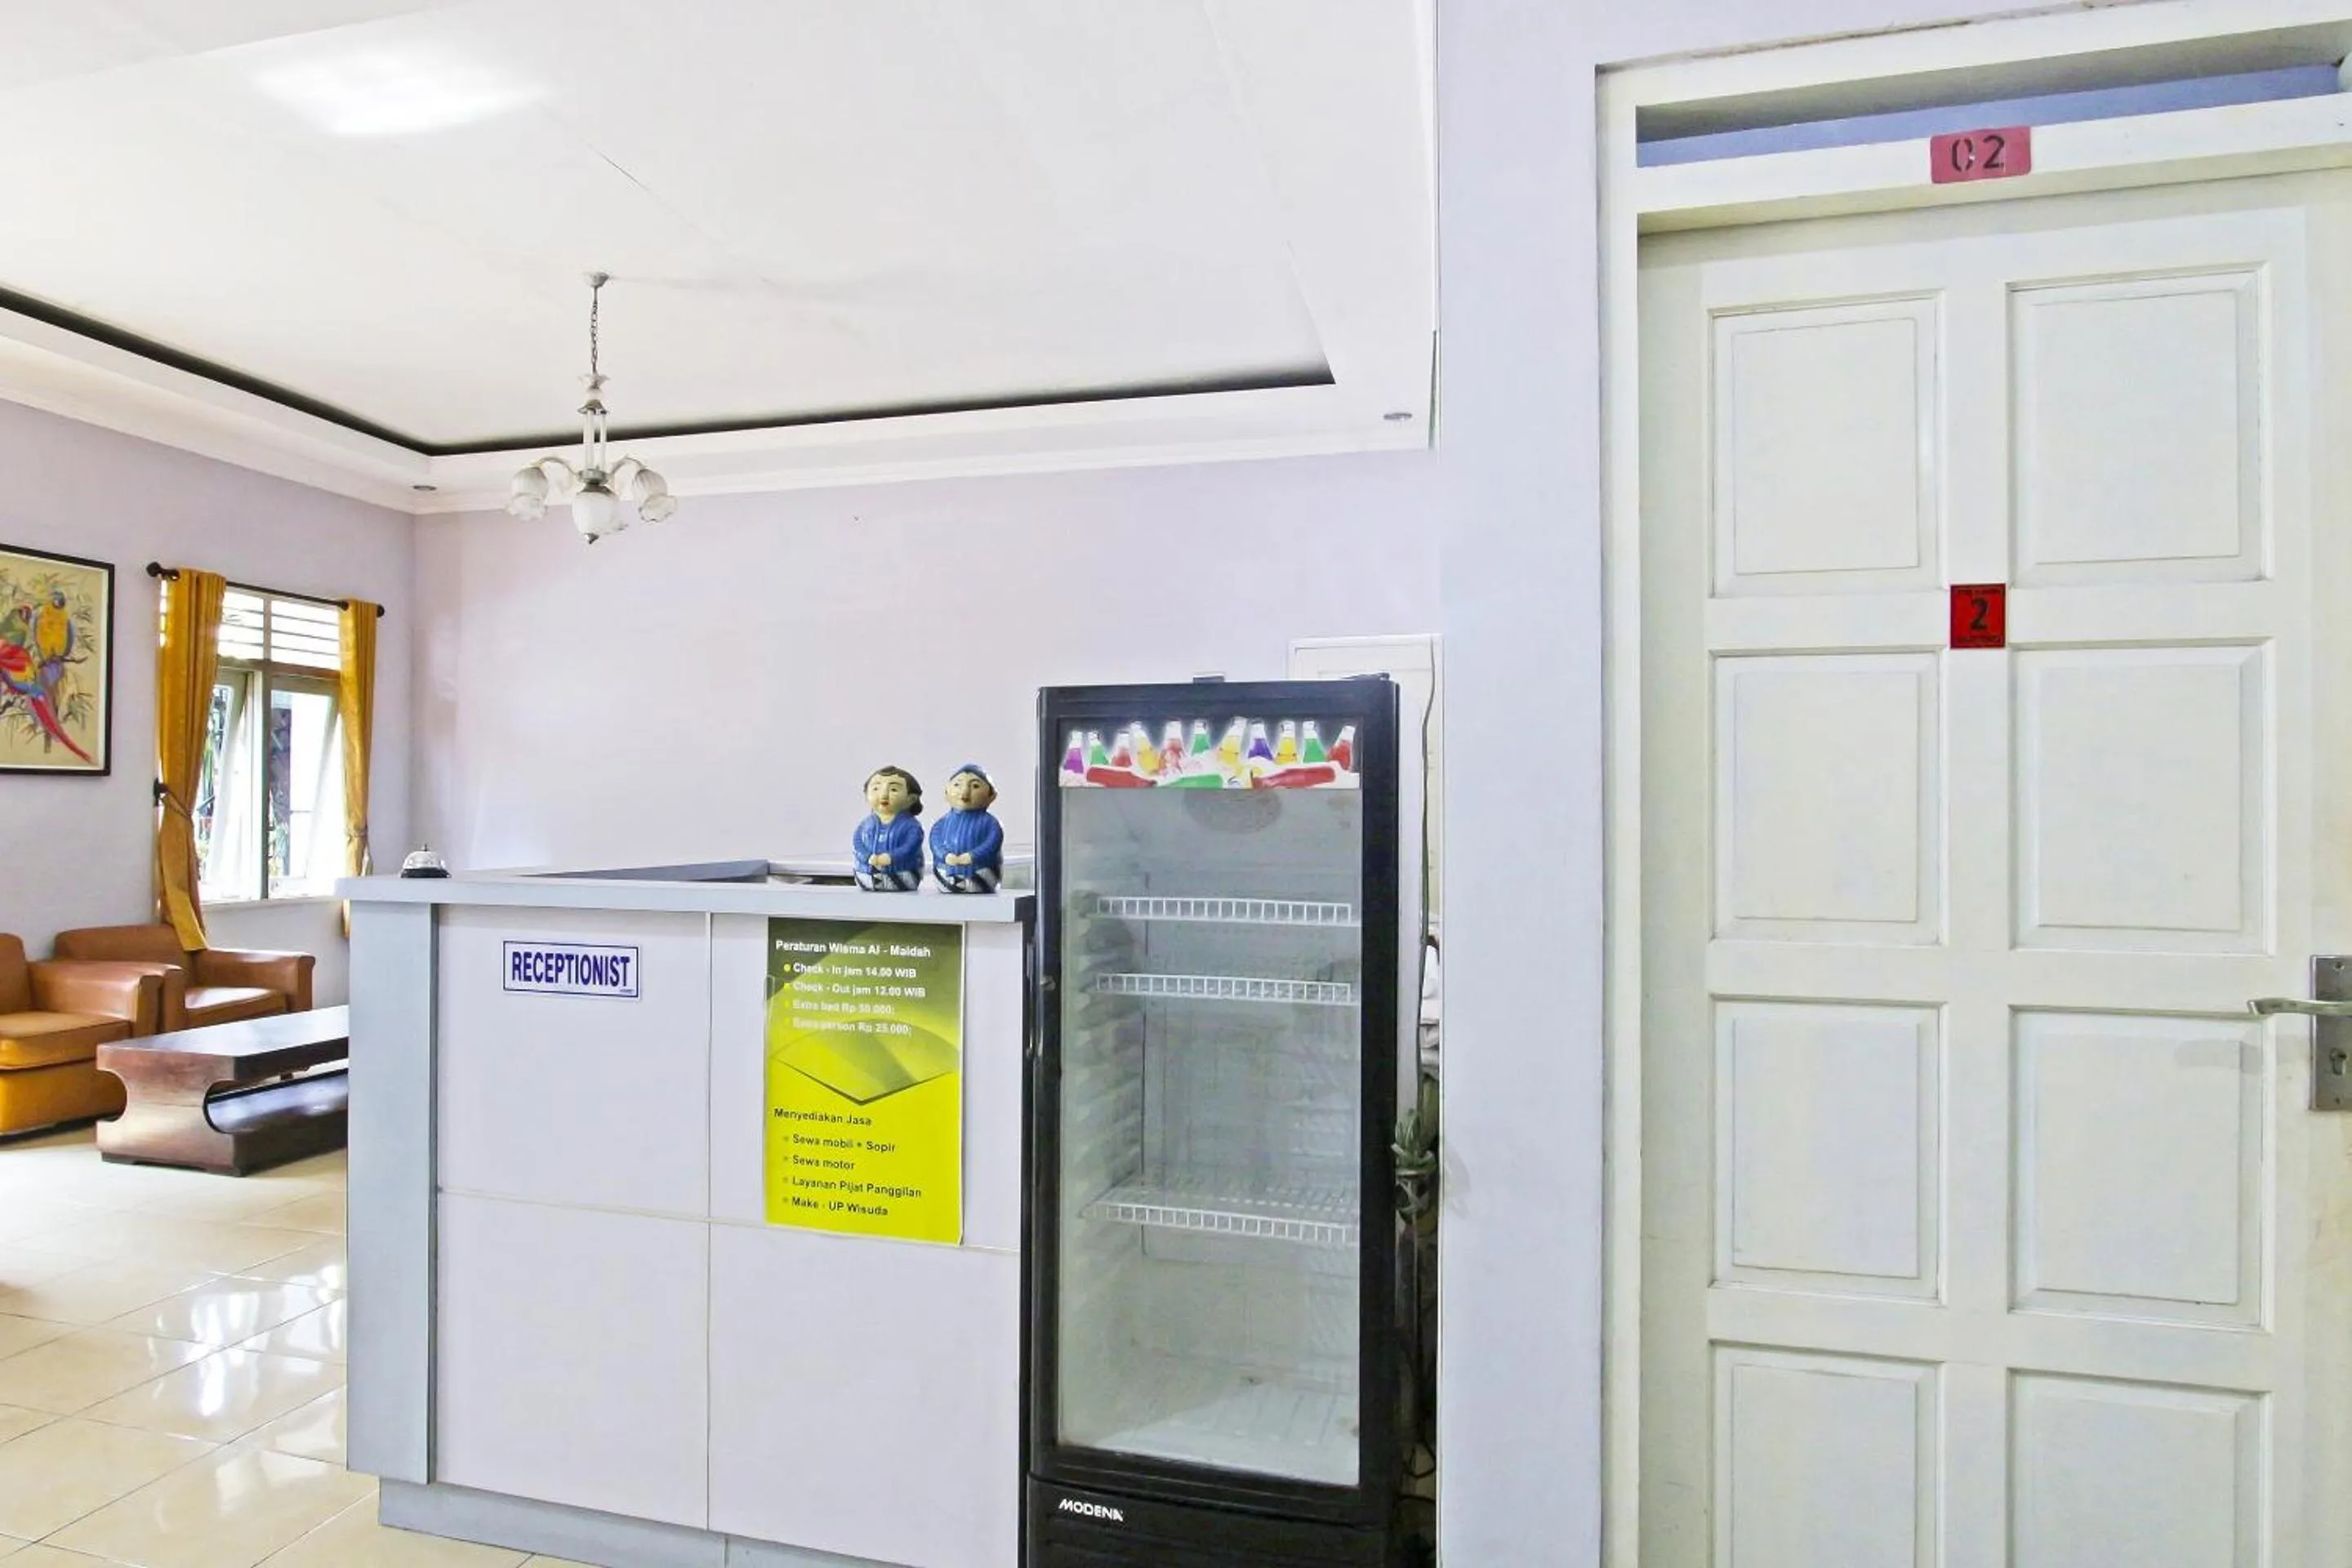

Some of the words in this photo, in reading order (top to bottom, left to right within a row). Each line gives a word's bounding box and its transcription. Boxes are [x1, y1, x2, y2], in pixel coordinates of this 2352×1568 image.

[1952, 135, 2004, 172] 02
[1971, 597, 1989, 630] 2
[776, 940, 826, 952] Peraturan
[829, 942, 866, 954] Wisma
[512, 951, 630, 987] RECEPTIONIST
[793, 962, 824, 974] Check
[895, 967, 916, 978] WIB
[792, 981, 824, 993] Check
[904, 987, 926, 998] WIB
[774, 1108, 843, 1123] Menyediakan
[846, 1114, 872, 1126] Jasa
[793, 1134, 820, 1145] Sewa
[866, 1141, 896, 1153] Sopir
[793, 1154, 820, 1166] Sewa
[822, 1159, 855, 1169] motor
[792, 1176, 836, 1189] Layanan
[866, 1183, 921, 1198] Panggilan
[792, 1197, 818, 1209] Make
[829, 1200, 844, 1211] UP
[847, 1203, 889, 1215] Wisuda
[1058, 1499, 1124, 1521] MODENA
